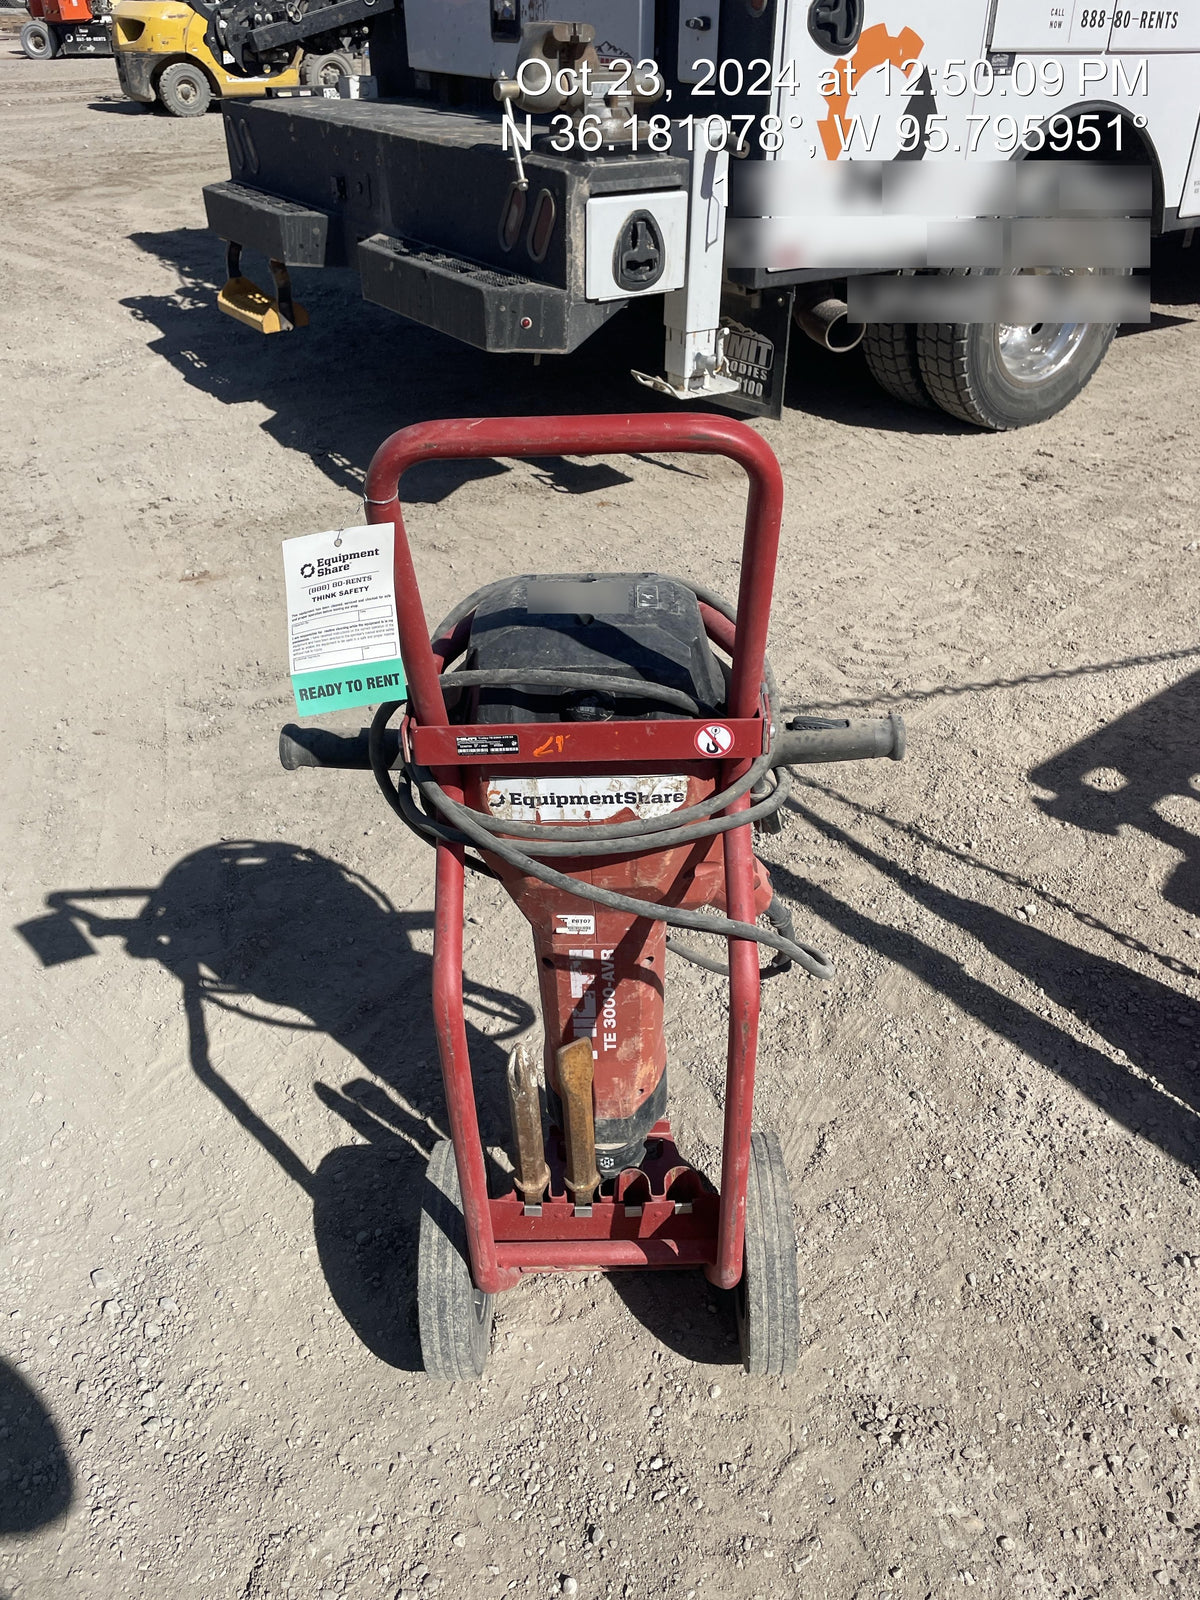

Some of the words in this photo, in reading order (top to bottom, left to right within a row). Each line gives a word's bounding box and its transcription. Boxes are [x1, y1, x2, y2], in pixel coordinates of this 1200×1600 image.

[1050, 8, 1065, 17] CALL
[1049, 20, 1063, 29] NOW
[317, 548, 380, 567] Equipment
[317, 563, 350, 577] Share
[312, 592, 337, 603] THINK
[338, 585, 370, 597] SAFETY
[299, 682, 342, 702] READY
[345, 679, 363, 693] TO
[366, 673, 400, 690] RENT
[509, 791, 685, 809] EquipmentShare
[600, 949, 617, 1029] 3000-AVR
[603, 1032, 617, 1052] TE
